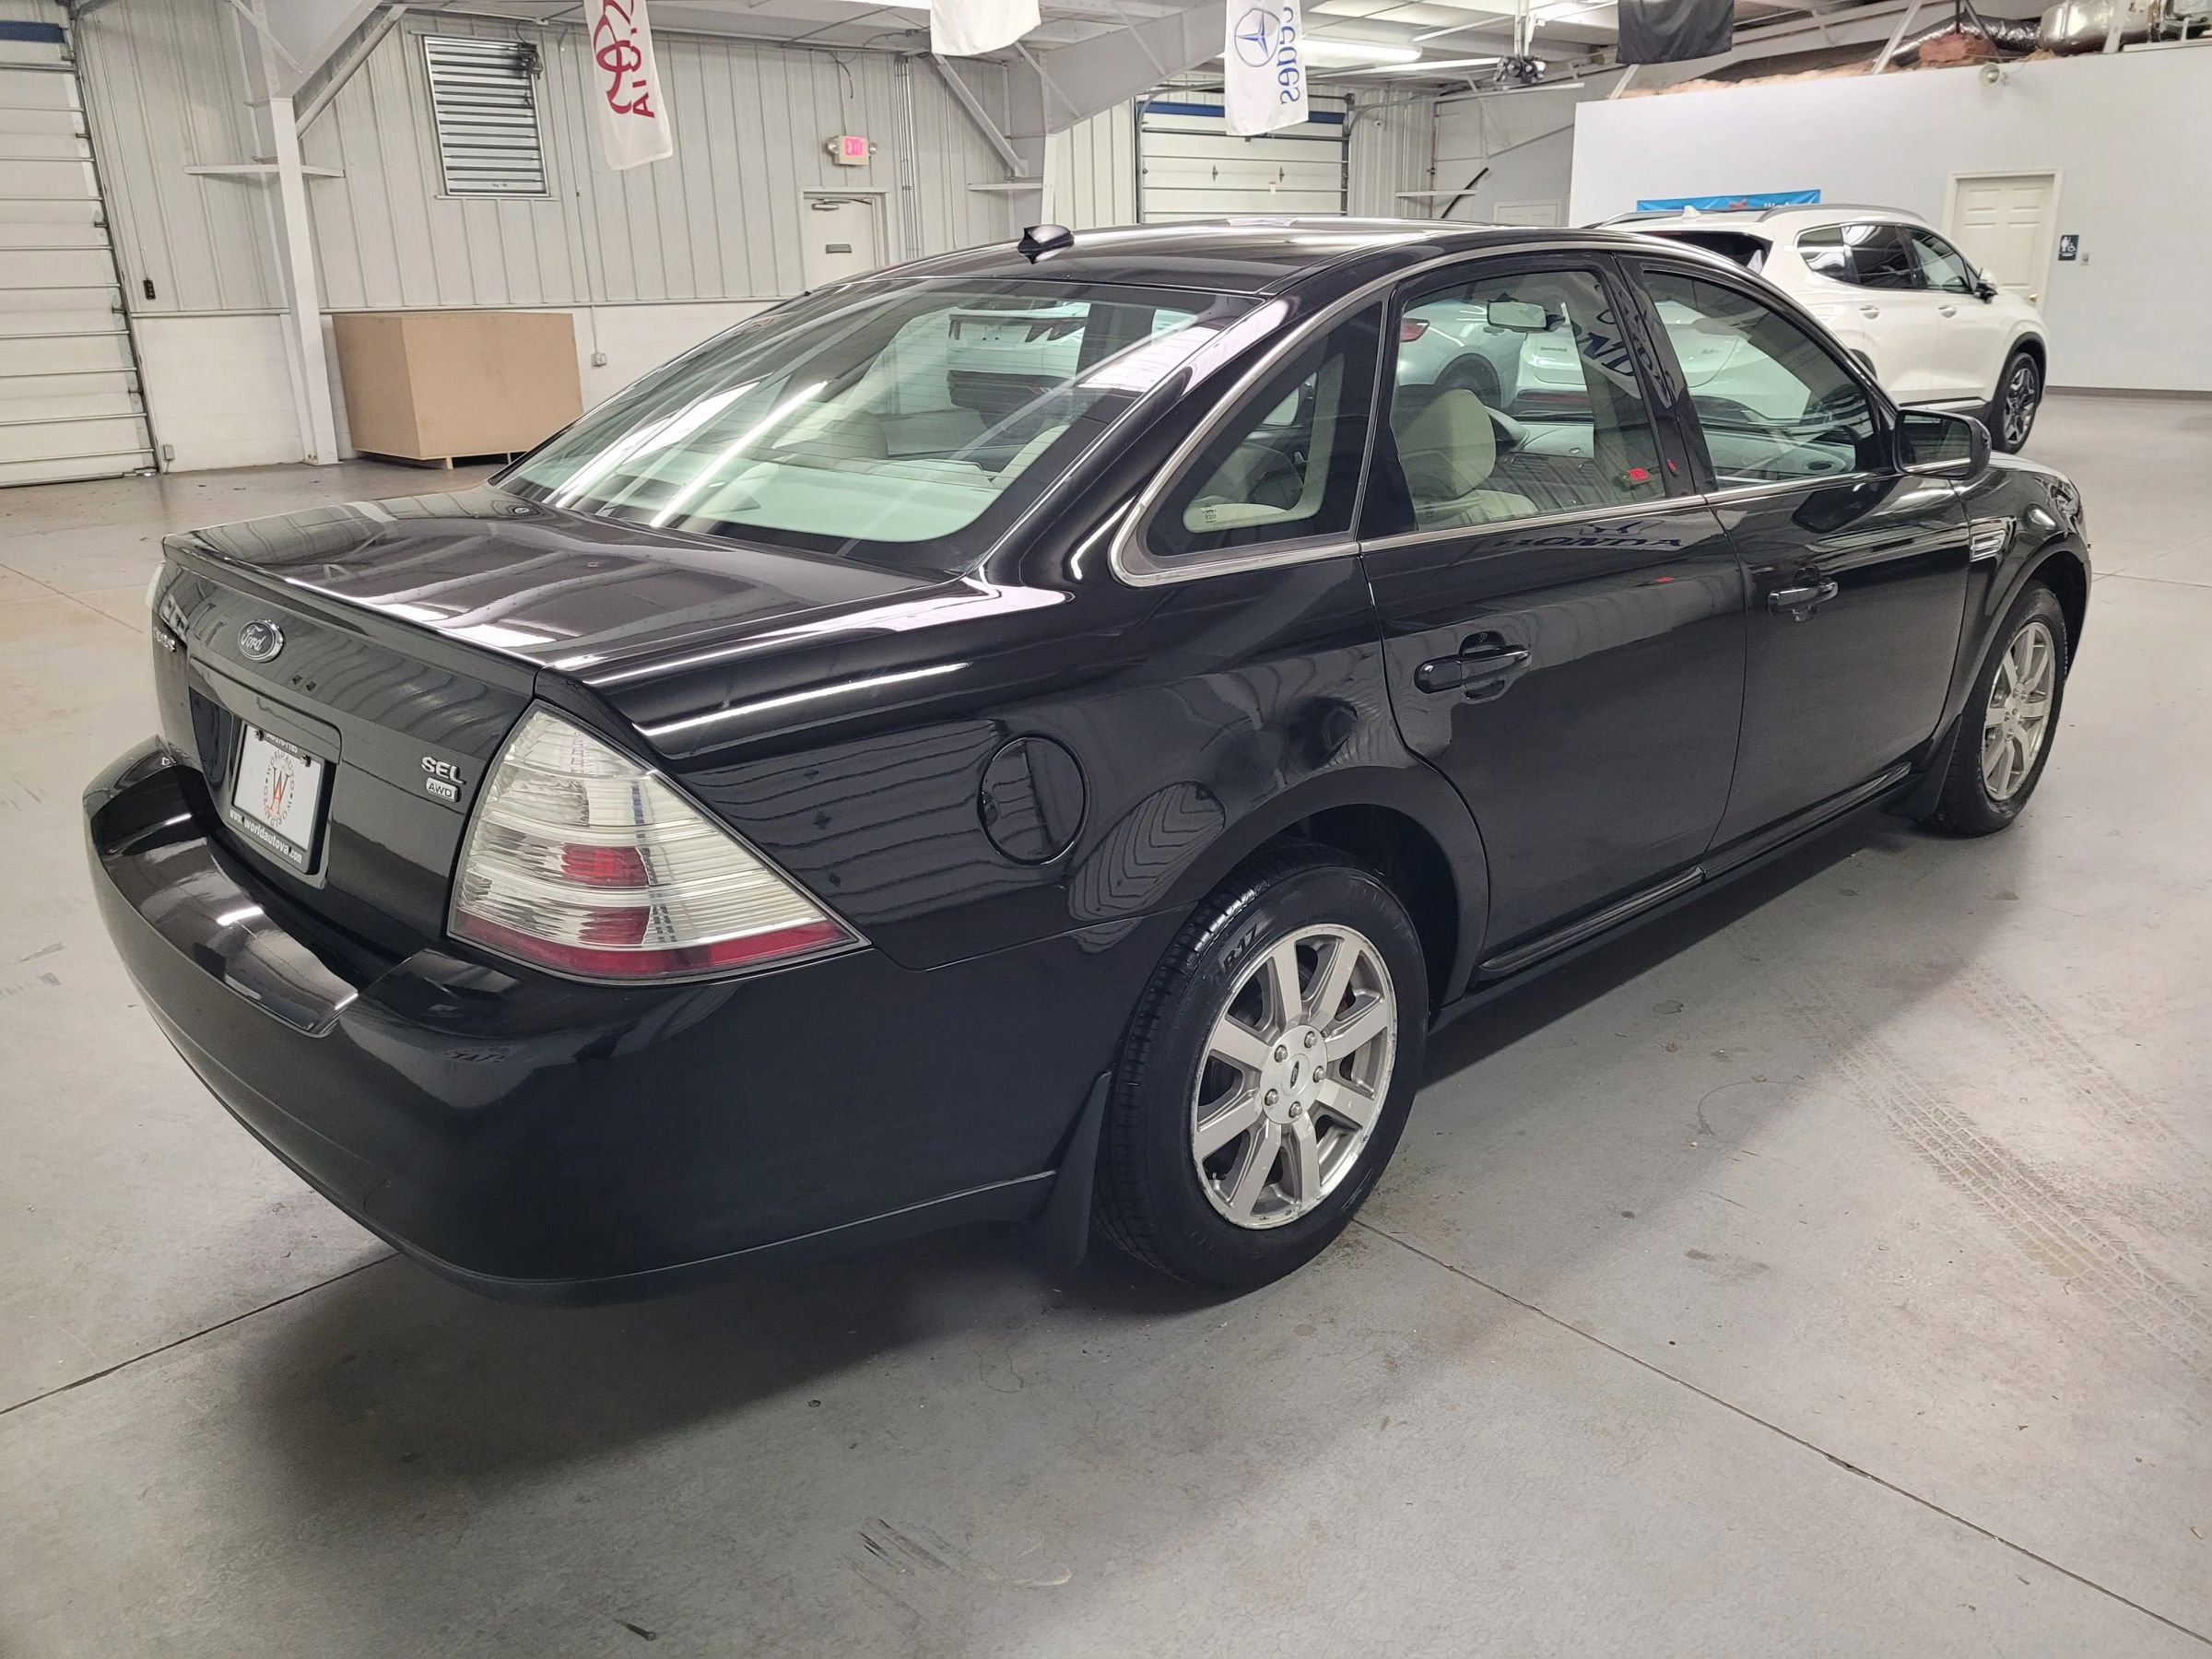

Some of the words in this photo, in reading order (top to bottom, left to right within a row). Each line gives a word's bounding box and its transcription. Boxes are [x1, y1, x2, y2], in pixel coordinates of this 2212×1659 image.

[241, 624, 267, 652] Ford
[421, 756, 464, 784] SEL
[429, 782, 453, 797] AWD
[1223, 924, 1257, 972] R17
